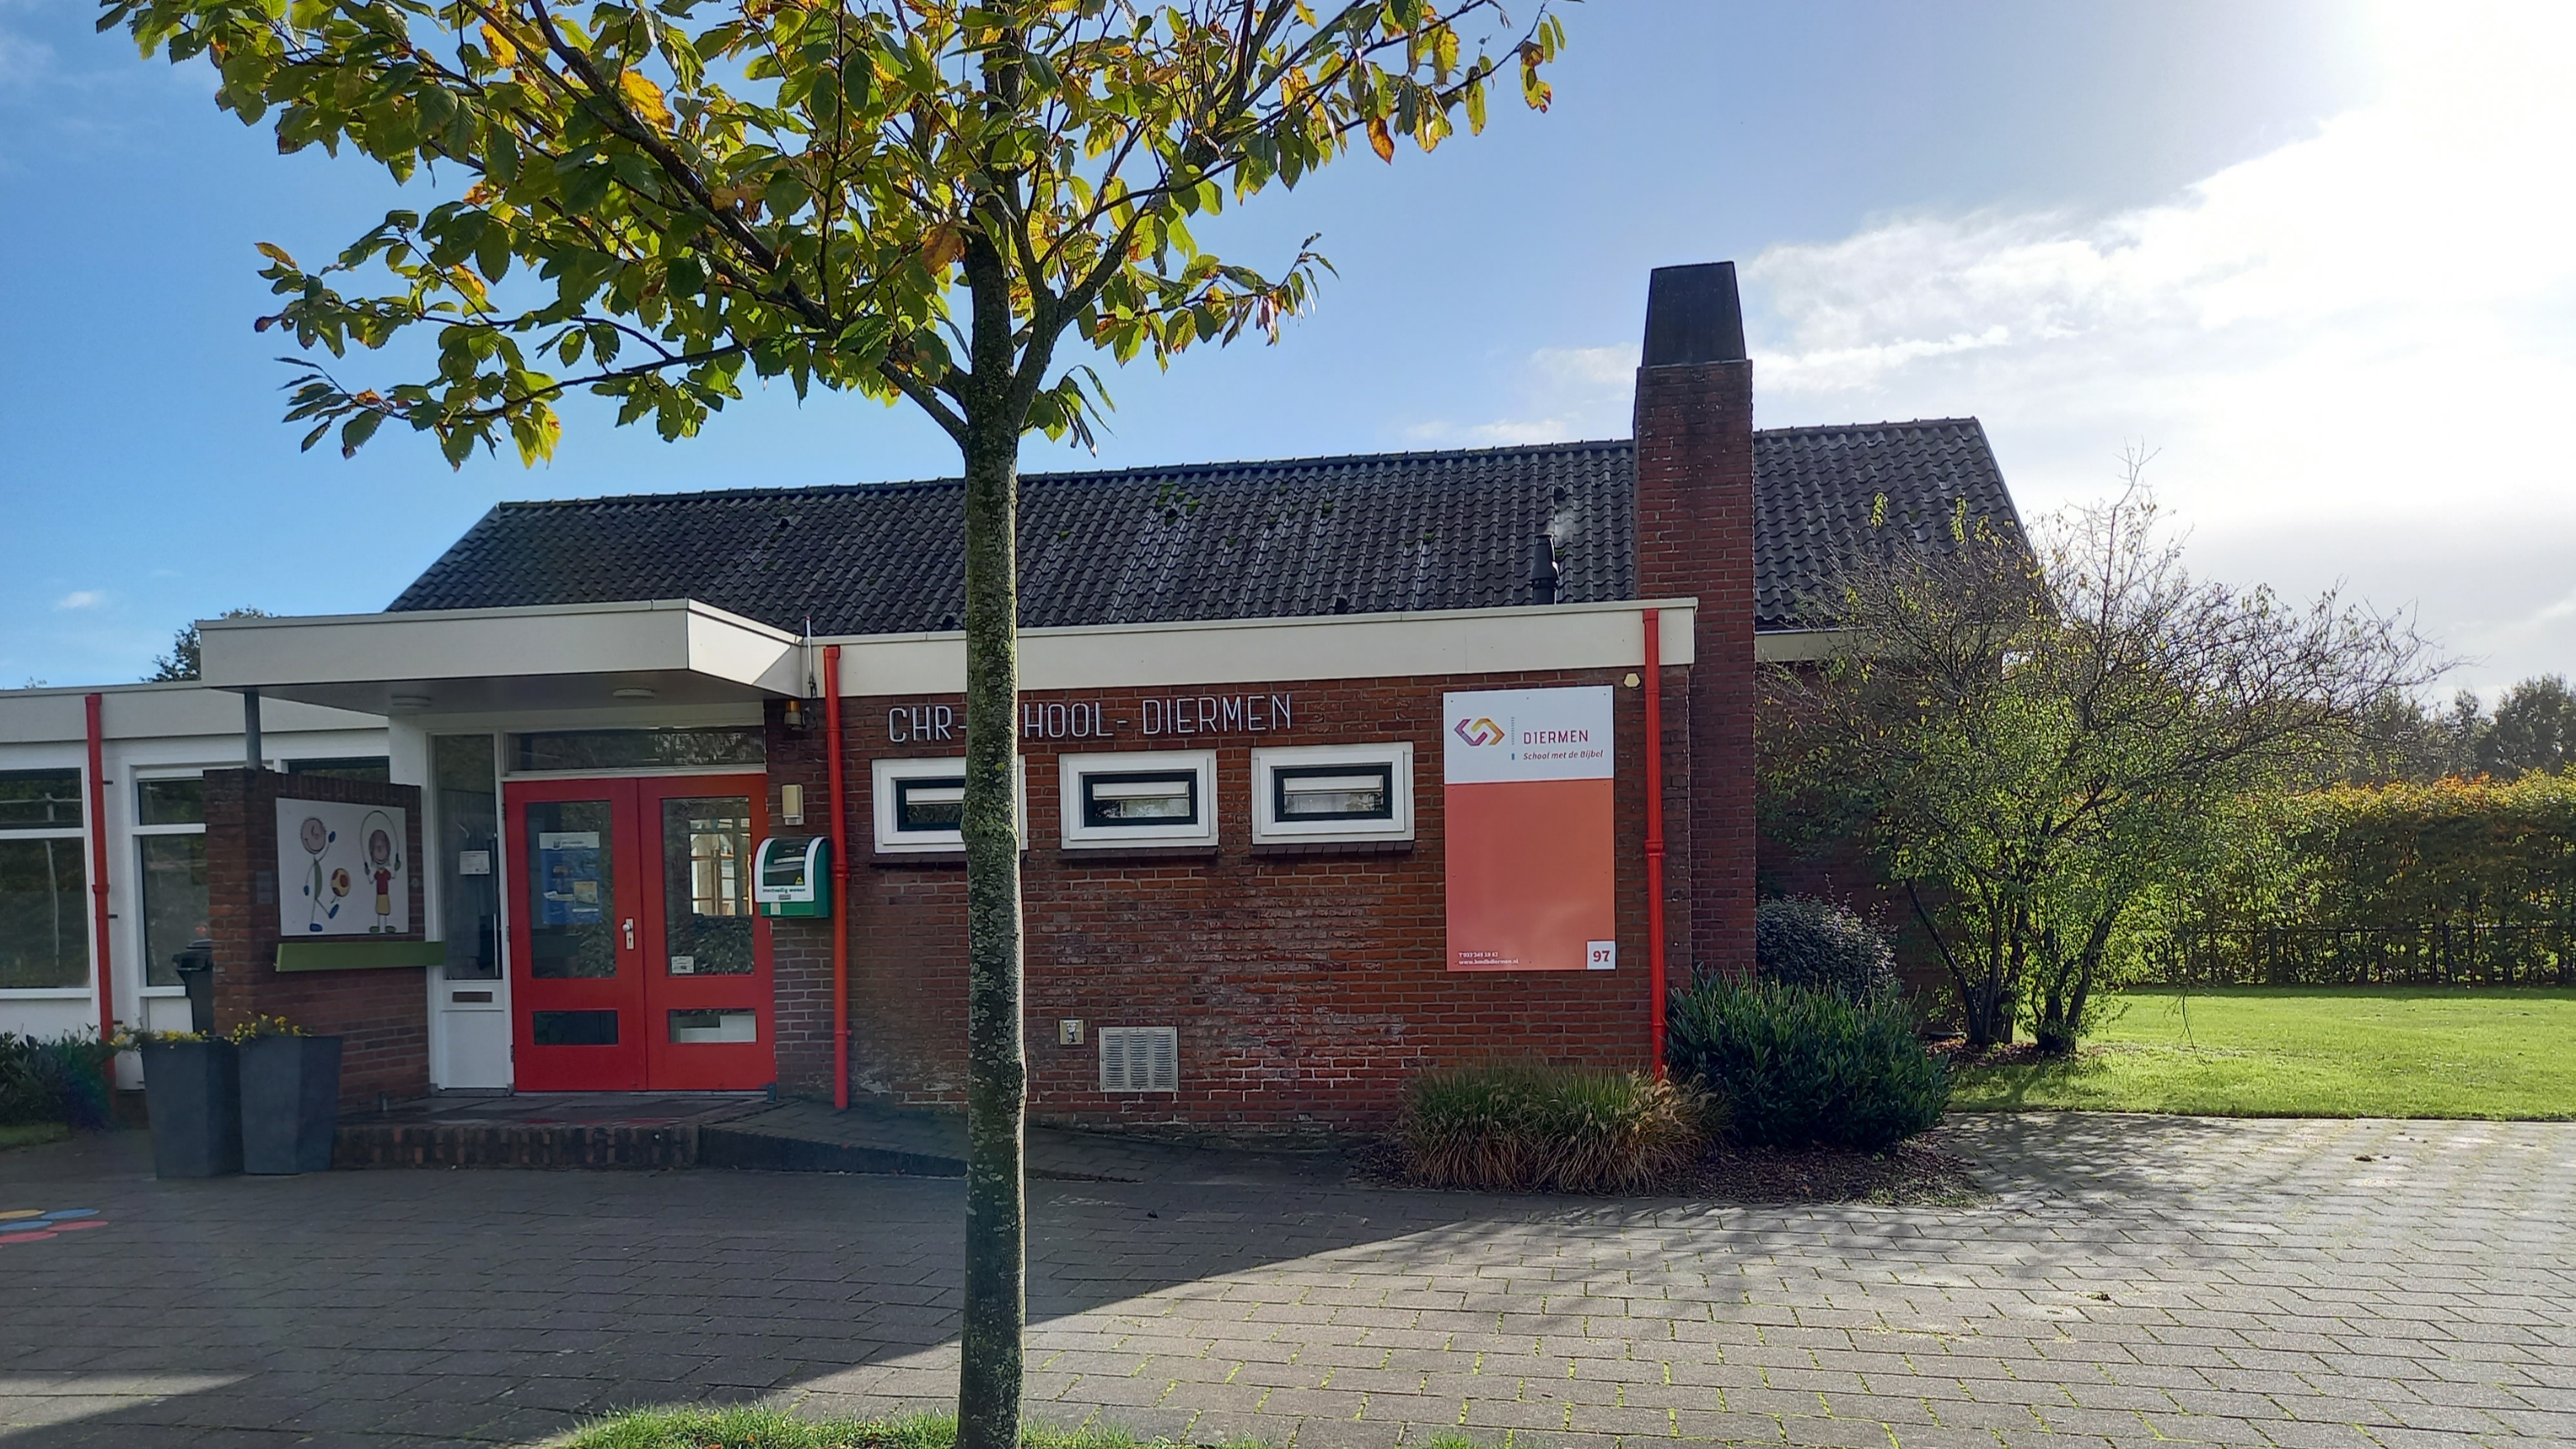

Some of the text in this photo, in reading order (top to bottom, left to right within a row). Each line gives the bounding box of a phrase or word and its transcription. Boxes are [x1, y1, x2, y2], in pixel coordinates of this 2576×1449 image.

[1142, 693, 1292, 734] DIERMEN
[1523, 729, 1589, 744] DIERMEN
[1523, 748, 1604, 760] School met de Bijbel
[1592, 950, 1611, 963] 97
